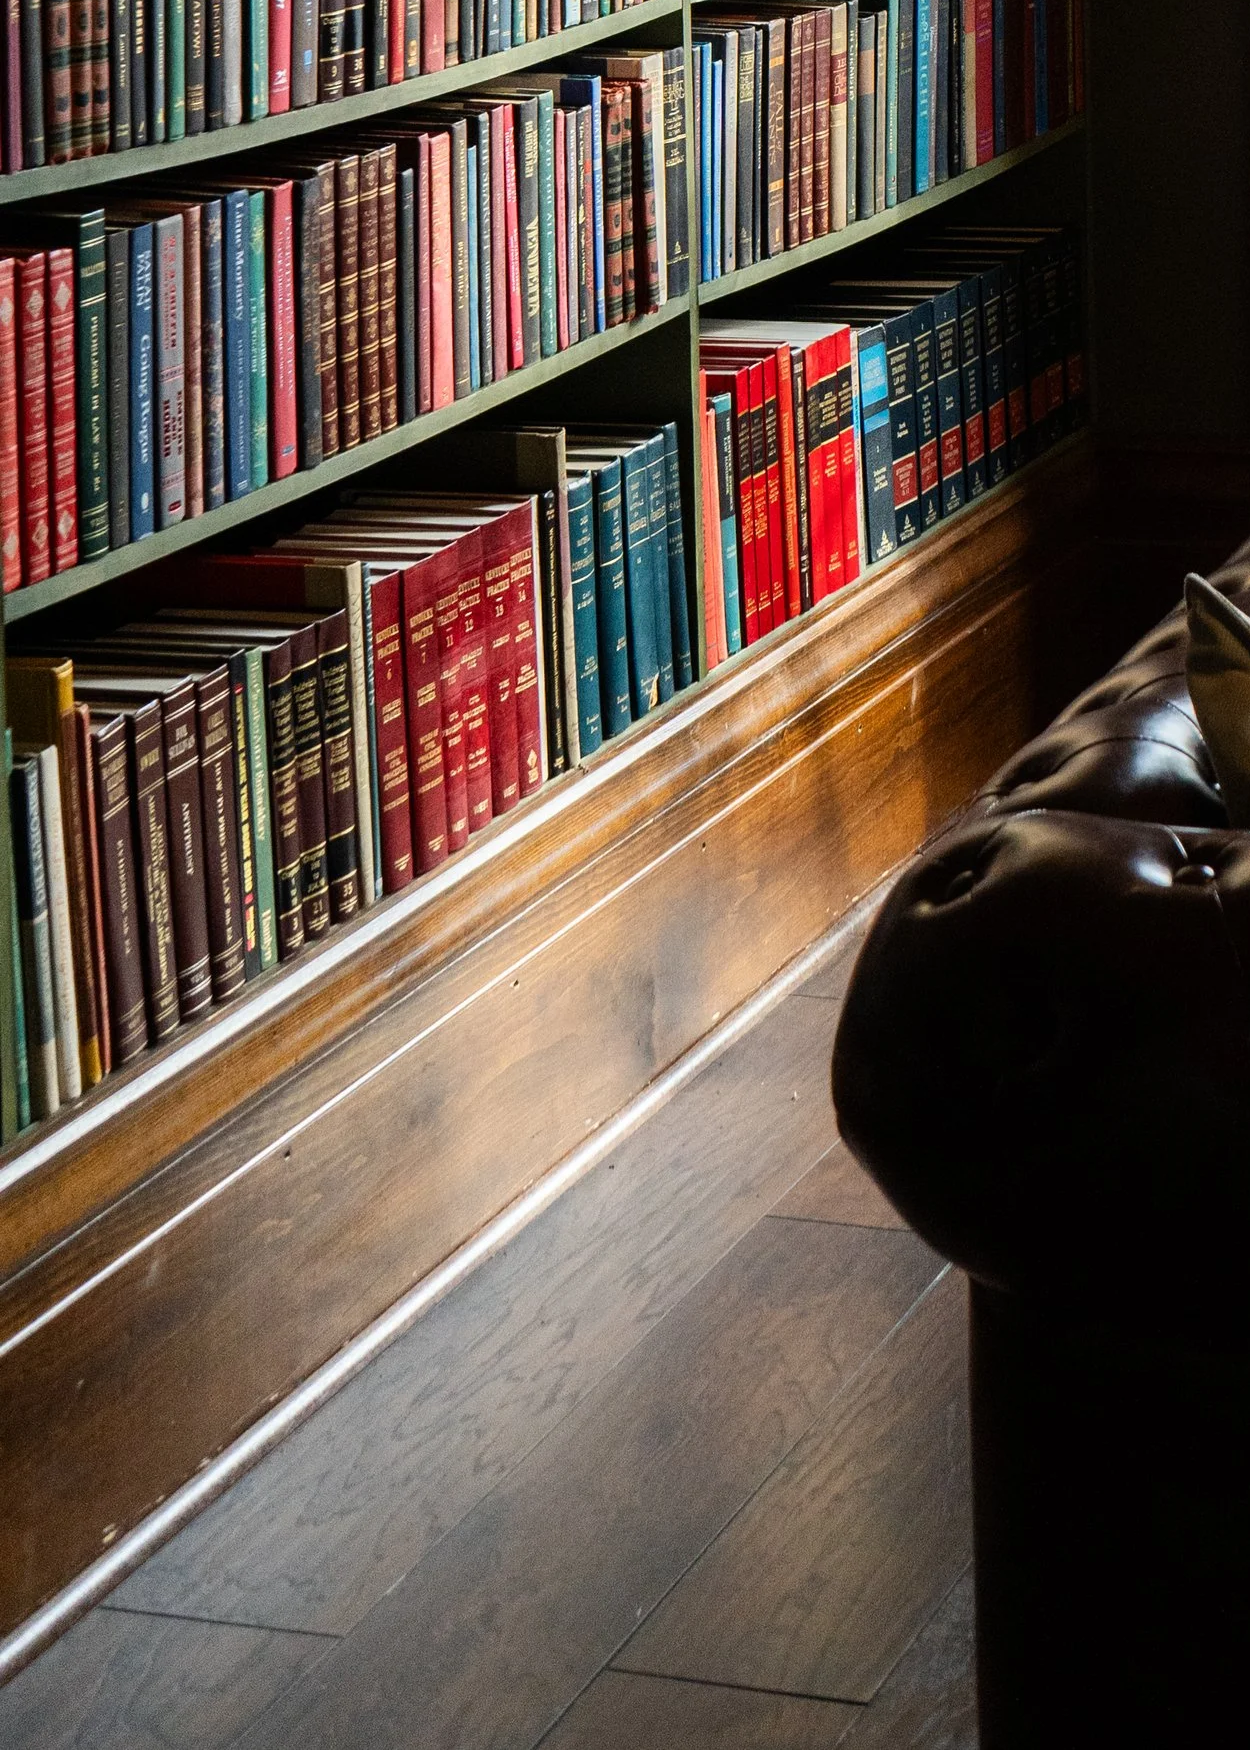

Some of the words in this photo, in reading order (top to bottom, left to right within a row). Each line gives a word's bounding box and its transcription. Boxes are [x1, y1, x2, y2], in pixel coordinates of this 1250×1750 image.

[775, 89, 783, 132] FALL
[235, 202, 245, 248] Liane
[136, 254, 145, 306] PALIN
[231, 252, 244, 321] Moriarty
[526, 216, 540, 318] VENDETTA
[138, 334, 150, 397] Going
[138, 400, 150, 464] Rogue
[783, 412, 791, 456] Personal
[786, 505, 796, 571] Management
[181, 802, 194, 875] ANTITRUST
[222, 877, 231, 904] LAW
